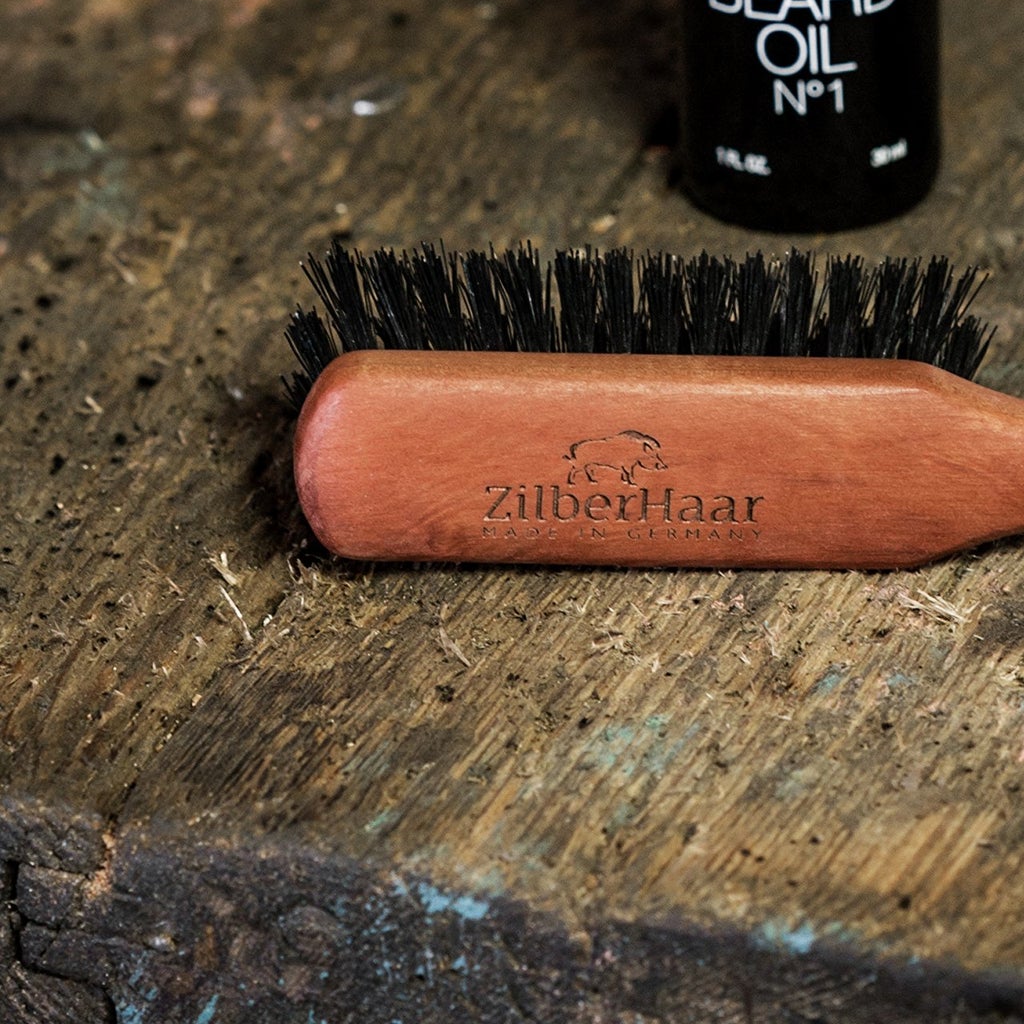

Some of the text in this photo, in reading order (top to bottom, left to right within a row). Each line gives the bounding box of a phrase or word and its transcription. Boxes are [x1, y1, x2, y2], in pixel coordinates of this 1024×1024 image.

[756, 23, 857, 76] OIL
[483, 485, 764, 524] ZilberHaar
[482, 527, 763, 541] MADE IN GERMANY
